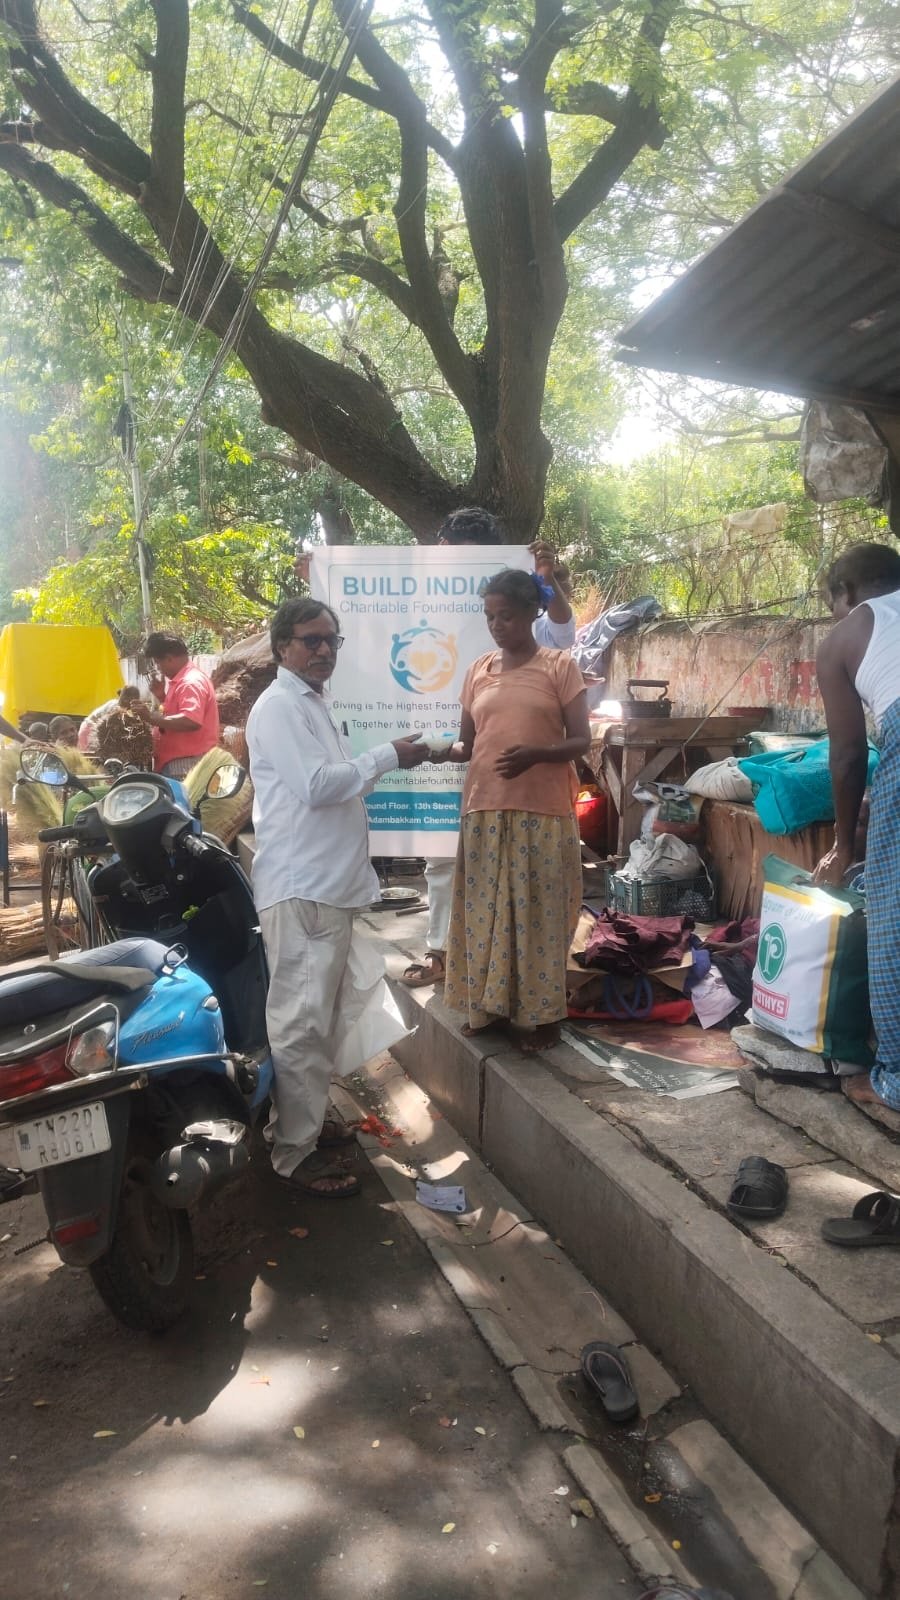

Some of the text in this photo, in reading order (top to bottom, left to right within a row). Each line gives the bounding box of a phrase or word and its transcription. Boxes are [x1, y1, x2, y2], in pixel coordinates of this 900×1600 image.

[343, 576, 418, 596] BUILD
[340, 601, 408, 614] Charitable
[333, 700, 362, 712] Giving
[376, 701, 393, 710] The
[396, 701, 432, 713] Highest
[435, 701, 461, 710] Form
[351, 719, 393, 730] Together
[396, 720, 411, 729] We
[414, 720, 432, 729] Can
[435, 720, 448, 729] Do
[366, 802, 387, 810] ound
[415, 802, 431, 810] 13th
[432, 802, 459, 811] Street,
